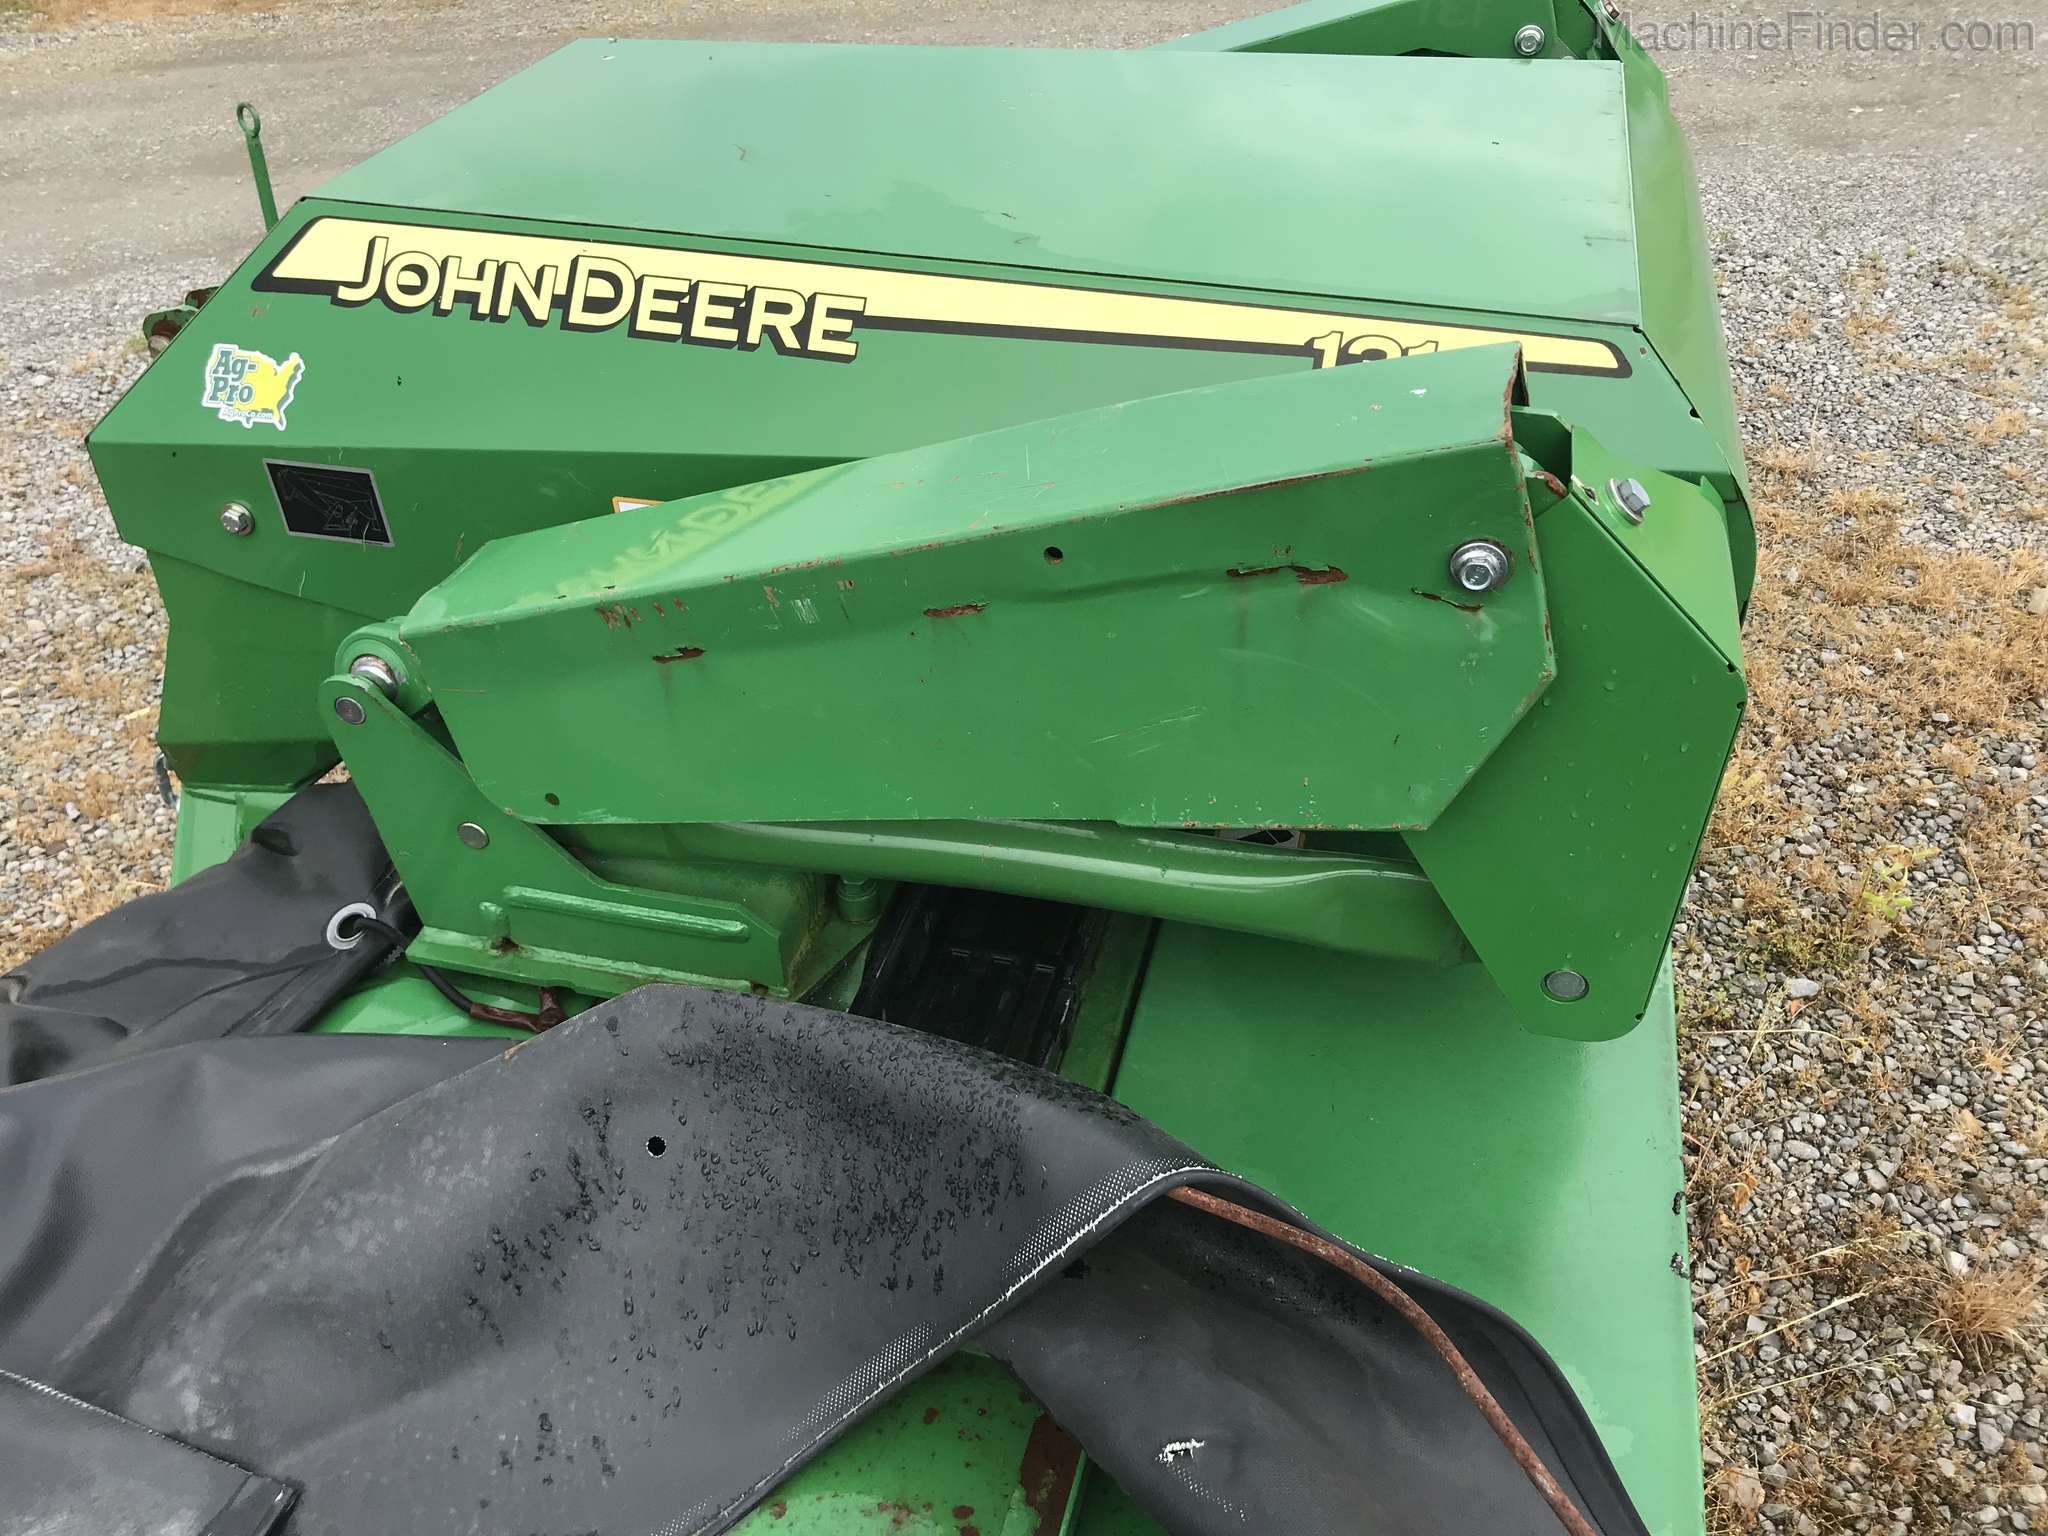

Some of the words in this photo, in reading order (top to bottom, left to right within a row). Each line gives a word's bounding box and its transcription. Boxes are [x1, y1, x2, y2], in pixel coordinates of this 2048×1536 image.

[333, 236, 558, 325] JOHN
[562, 254, 868, 361] DEERE
[211, 349, 258, 382] Ag-
[208, 376, 254, 403] Pro
